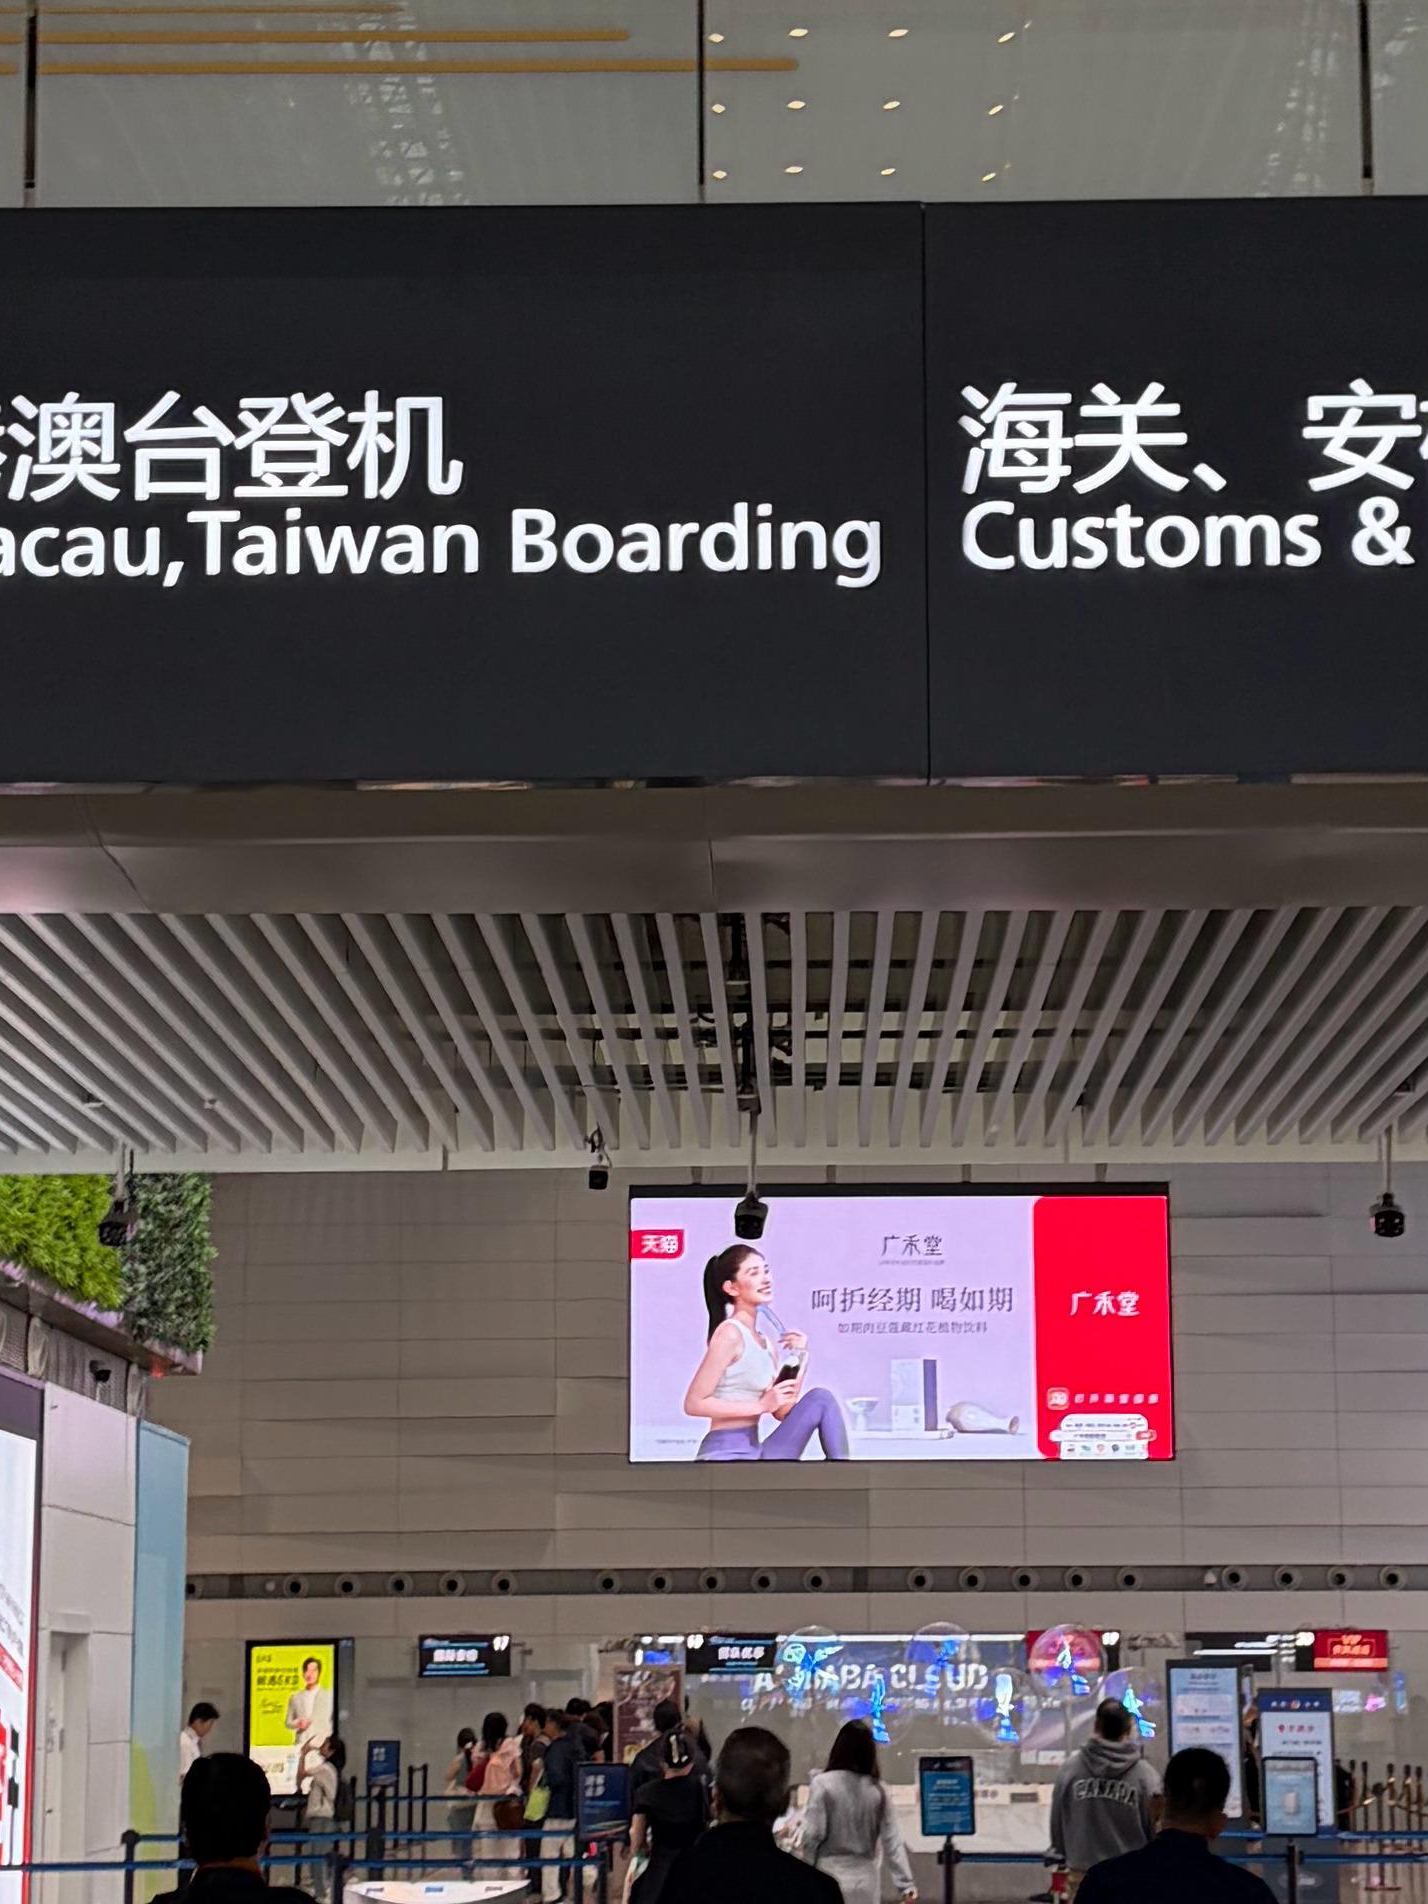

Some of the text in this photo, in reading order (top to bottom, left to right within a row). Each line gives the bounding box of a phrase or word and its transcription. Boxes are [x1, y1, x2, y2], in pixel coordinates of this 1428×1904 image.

[510, 500, 882, 589] Boarding
[961, 500, 1323, 571] Customs
[1350, 495, 1416, 567] &
[640, 1234, 680, 1256] 天猫
[881, 1233, 943, 1258] 广禾堂
[811, 1285, 1015, 1314] 呵护经期 喝如期
[1069, 1289, 1141, 1317] 广禾堂
